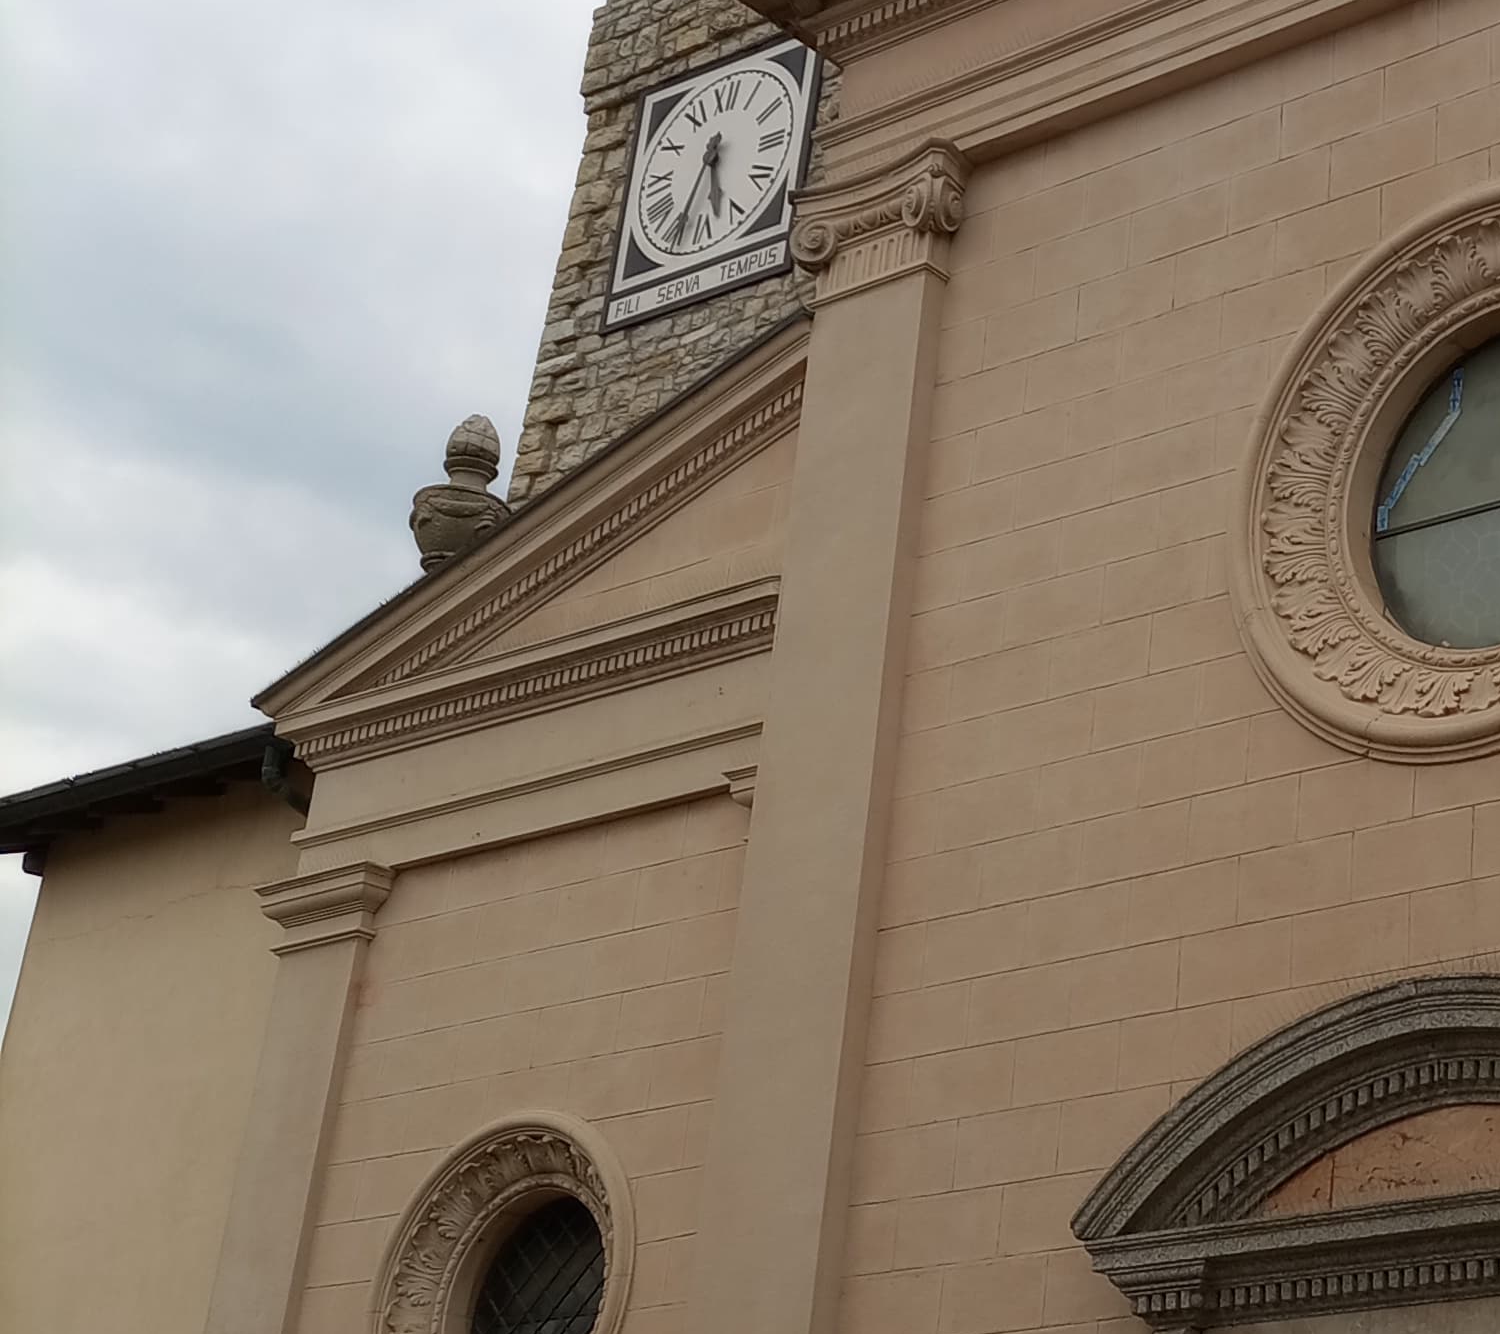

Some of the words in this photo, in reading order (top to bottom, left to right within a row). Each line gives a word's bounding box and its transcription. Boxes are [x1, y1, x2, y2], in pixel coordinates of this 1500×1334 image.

[714, 80, 741, 117] XII
[756, 97, 783, 125] II
[685, 100, 707, 133] XI
[661, 137, 685, 156] X
[758, 128, 786, 152] III
[646, 170, 673, 198] IX
[748, 164, 773, 191] IV
[729, 198, 745, 225] V
[692, 213, 712, 245] VI
[614, 295, 641, 319] FILI
[656, 275, 700, 305] SERVA
[720, 246, 778, 282] TEMPUS
